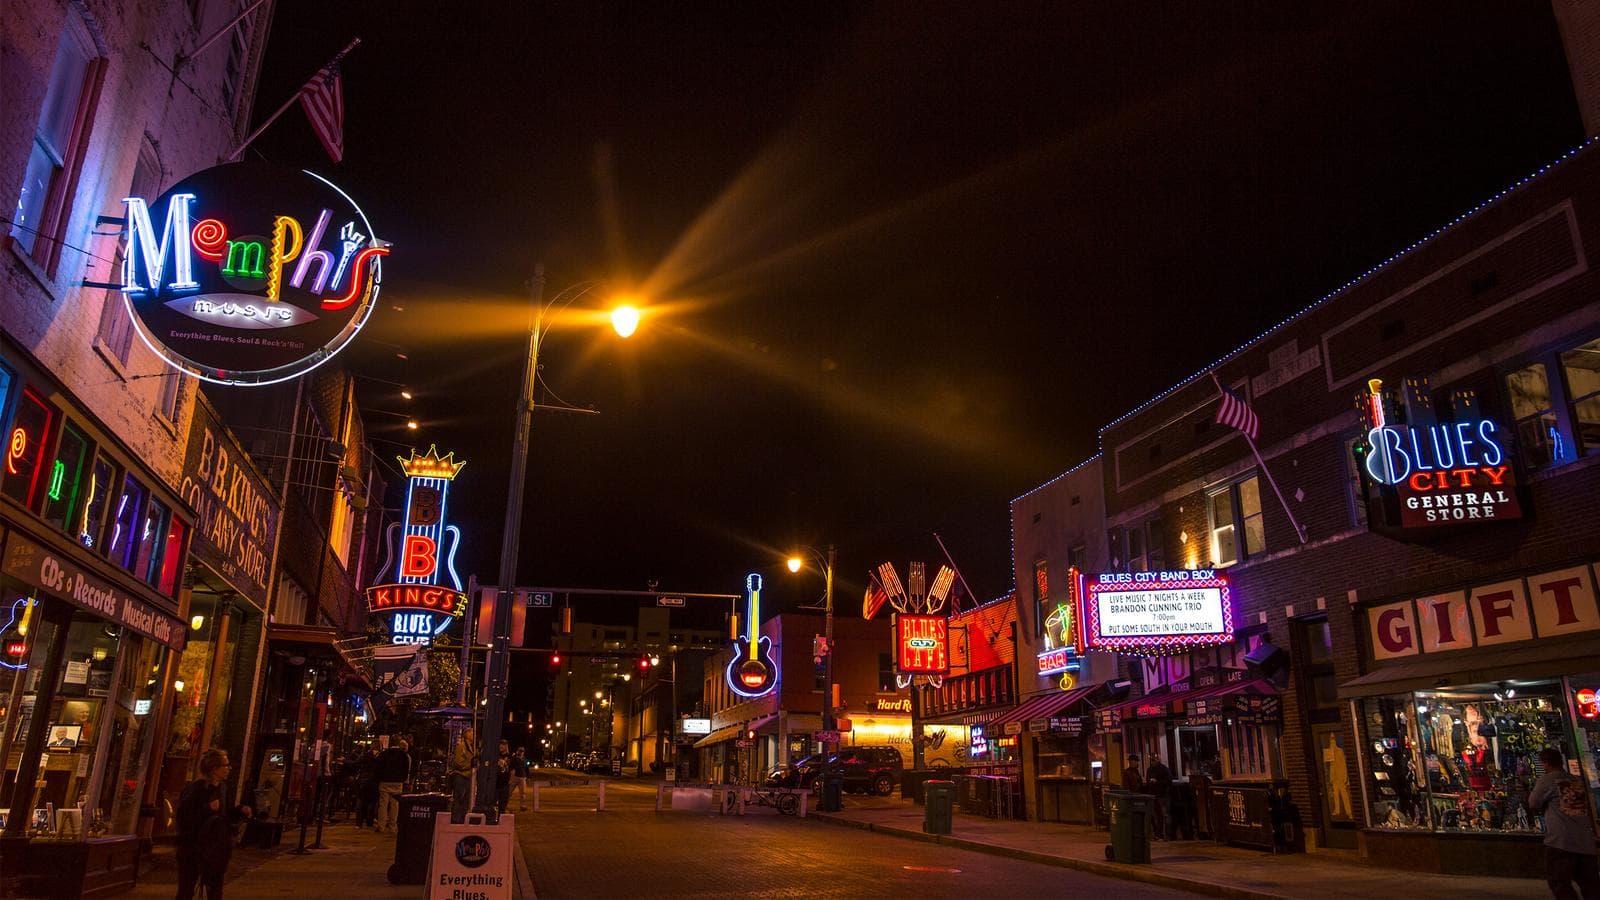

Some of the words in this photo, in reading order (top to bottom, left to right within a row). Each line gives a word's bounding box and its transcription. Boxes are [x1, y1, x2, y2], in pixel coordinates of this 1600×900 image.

[170, 330, 211, 341] Everything
[213, 334, 236, 343] Blues,
[237, 336, 254, 345] Soul
[1384, 421, 1501, 484] BLUES
[1409, 466, 1507, 491] CITY
[1406, 490, 1509, 509] GENERAL
[1426, 505, 1495, 521] STORE
[237, 532, 266, 590] STORE
[1100, 573, 1131, 584] BLUES
[1135, 572, 1157, 582] CITY
[1160, 571, 1189, 581] BAND
[1192, 570, 1215, 580] BOX
[40, 556, 65, 592] CDs
[73, 573, 116, 616] Records
[121, 597, 155, 634] Musical
[154, 616, 171, 643] Gifts
[1110, 595, 1123, 603] LIVE
[1126, 594, 1145, 603] MUSIC
[1148, 594, 1152, 602] 7
[1154, 593, 1178, 602] NIGHTS
[1187, 592, 1205, 600] WEEK
[1110, 604, 1146, 613] BRANDON
[1148, 602, 1182, 612] CUNNING
[1185, 602, 1202, 611] TRIO
[394, 613, 433, 634] BLUES
[1153, 613, 1175, 621] 7:00pm
[903, 618, 945, 639] BLUES
[1108, 625, 1120, 634] PUT
[1122, 624, 1138, 633] SOME
[1140, 624, 1160, 633] SOUTH
[1163, 623, 1169, 631] IN
[1171, 623, 1187, 631] YOUR
[1189, 622, 1213, 631] MOUTH
[904, 641, 945, 669] CAFE
[1038, 652, 1066, 671] BAR
[1200, 675, 1214, 687] OPEN
[1227, 671, 1242, 682] LATE
[877, 699, 902, 710] Hard
[440, 874, 503, 887] Everything
